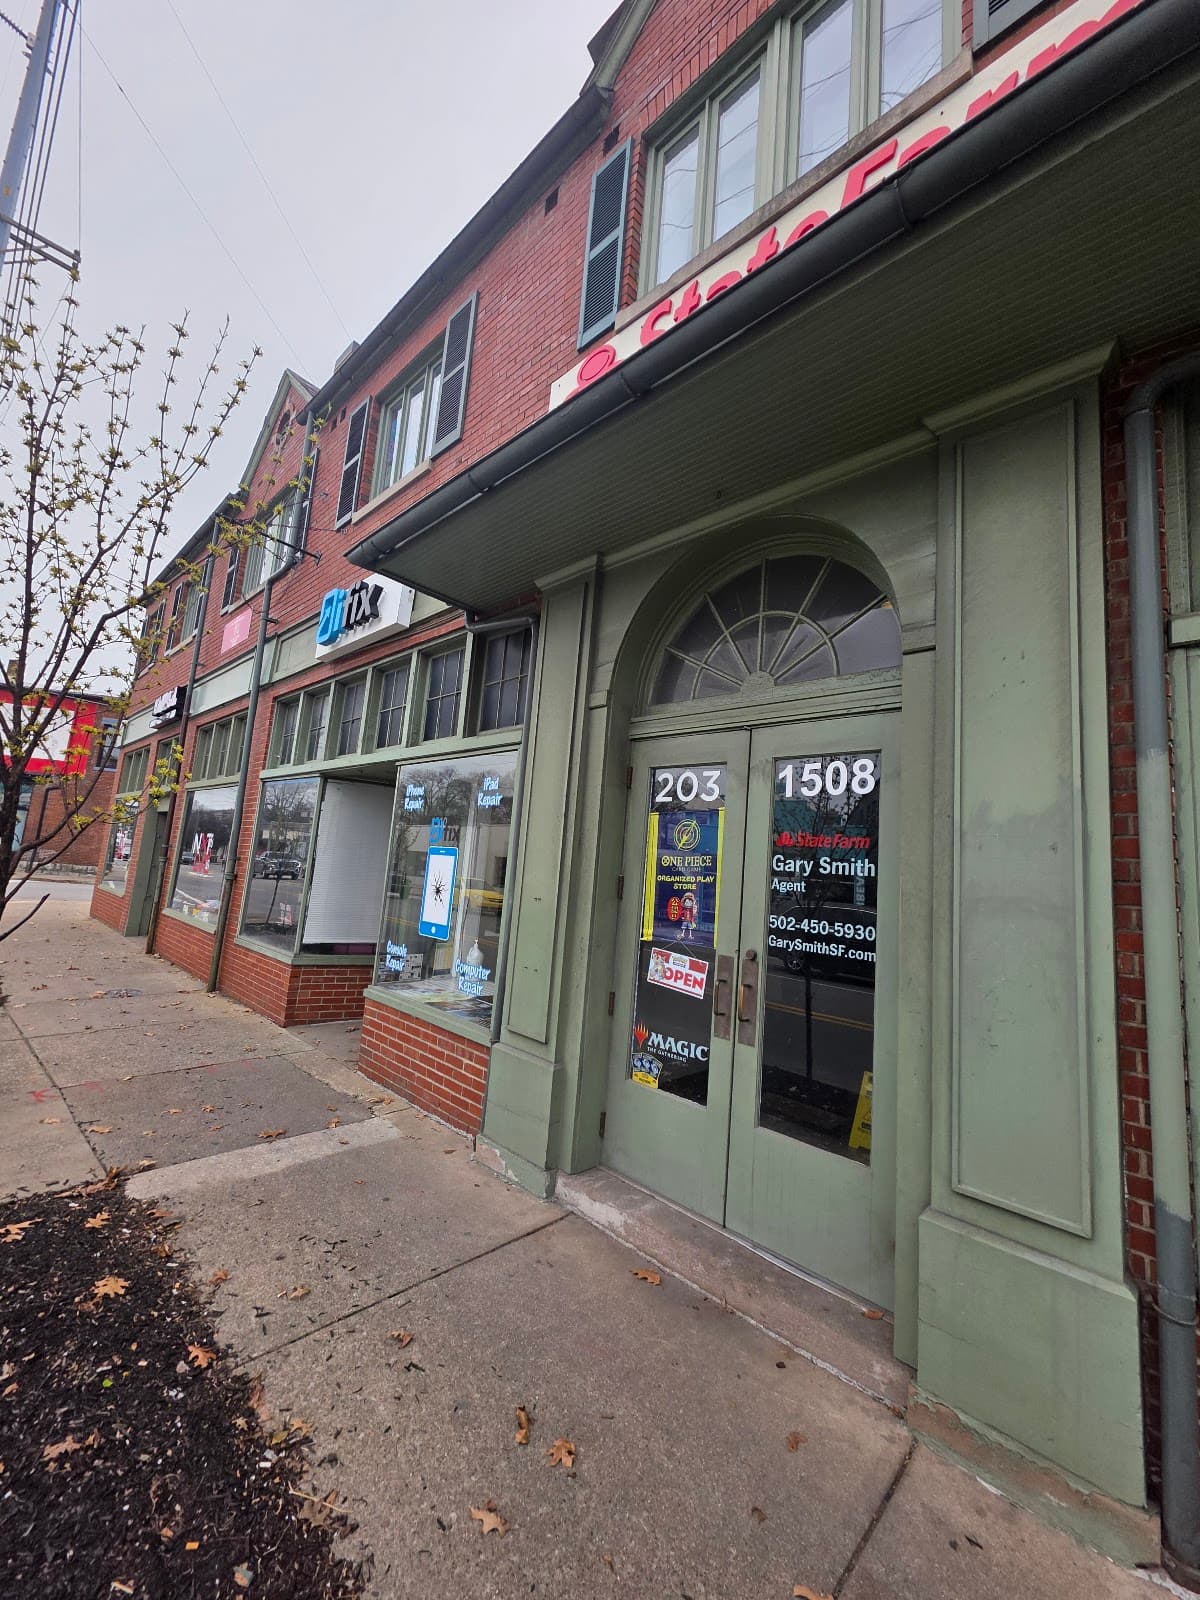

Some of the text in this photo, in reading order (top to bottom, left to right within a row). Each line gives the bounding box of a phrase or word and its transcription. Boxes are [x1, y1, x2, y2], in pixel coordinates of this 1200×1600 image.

[483, 776, 500, 790] iPad
[655, 770, 721, 802] 203
[778, 759, 876, 797] 1508
[404, 797, 425, 811] Repair
[477, 792, 504, 808] Repair
[661, 855, 712, 867] ONE PIECE
[772, 854, 876, 877] Gary Smith
[657, 875, 715, 883] ORGANIZED PLAY
[771, 878, 807, 893] Agent
[769, 914, 876, 942] 502-450-5930
[768, 934, 877, 962] GarySmithSF.com
[385, 954, 406, 972] Repair
[455, 958, 491, 981] Computer
[458, 976, 484, 997] Repair
[663, 967, 705, 991] OPEN
[647, 1031, 710, 1062] MAGIC
[647, 1046, 687, 1063] THE GATHERING
